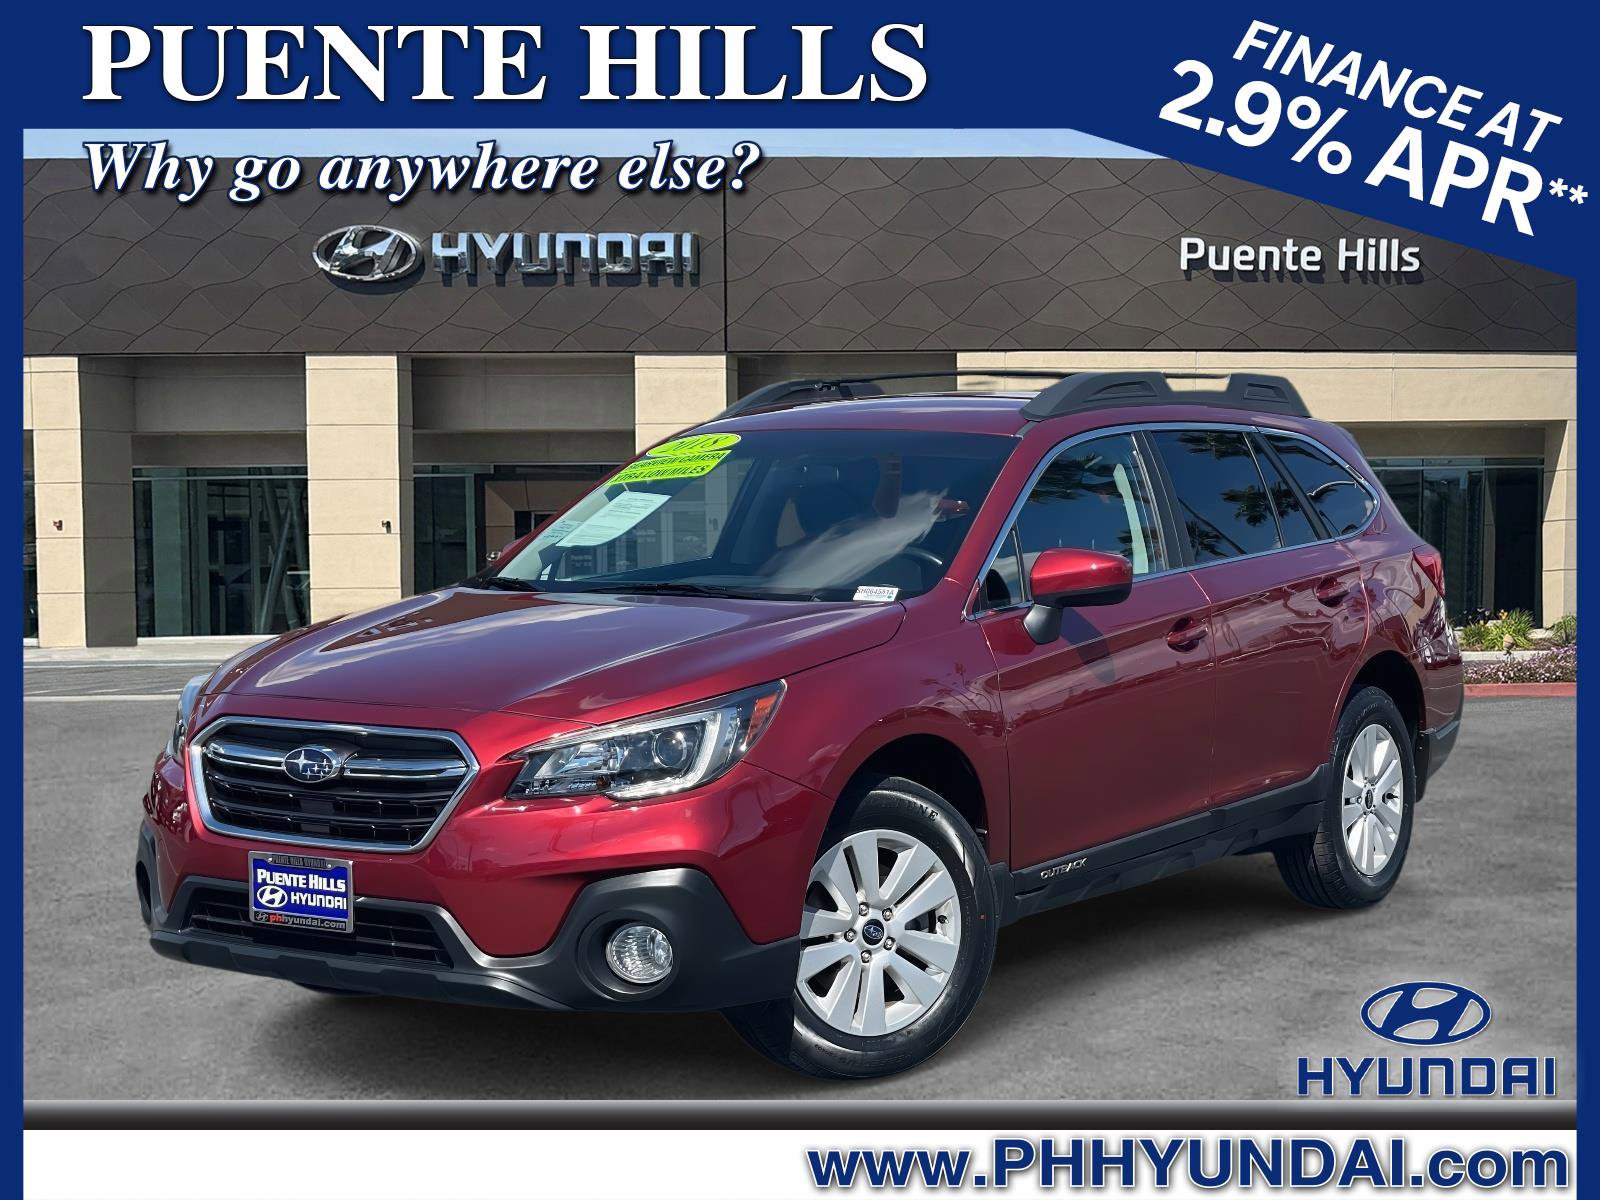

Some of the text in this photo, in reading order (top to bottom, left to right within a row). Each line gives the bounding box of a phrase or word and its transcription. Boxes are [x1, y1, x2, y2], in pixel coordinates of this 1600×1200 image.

[432, 232, 699, 274] HYUNDAI
[1180, 237, 1420, 272] Puente Hills
[1040, 857, 1088, 880] OUTBACK
[257, 869, 346, 893] PUENTE HILLS
[290, 891, 348, 910] HYUNDAI
[270, 913, 346, 929] phhyundai.com
